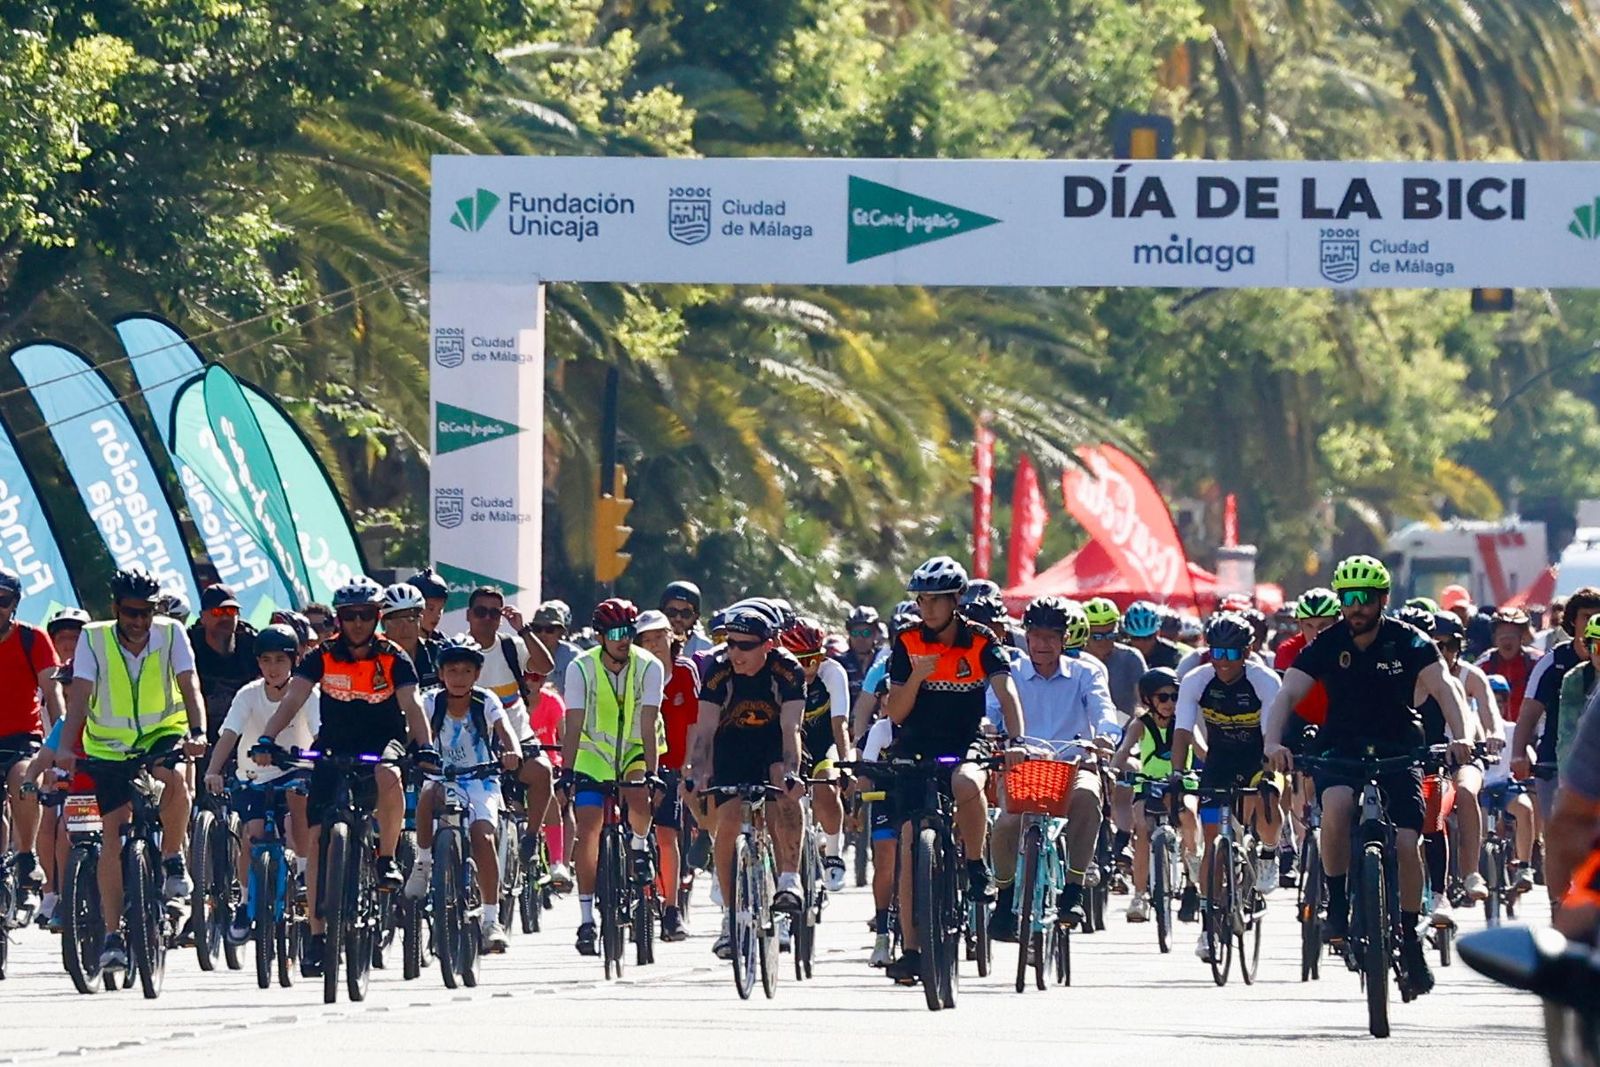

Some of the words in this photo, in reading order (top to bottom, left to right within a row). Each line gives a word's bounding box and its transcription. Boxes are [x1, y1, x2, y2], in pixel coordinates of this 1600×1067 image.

[1064, 163, 1176, 218] DÍA
[1197, 176, 1279, 219] DE
[1302, 177, 1382, 220] LA
[1403, 177, 1526, 221] BICI
[509, 192, 635, 214] Fundación
[722, 199, 786, 216] Ciudad
[852, 207, 869, 226] El
[869, 208, 905, 227] Corte
[905, 205, 960, 233] Inglés
[509, 215, 599, 242] Unicaja
[722, 220, 744, 236] de
[749, 221, 813, 240] Málaga
[1369, 238, 1429, 254] Ciudad
[1369, 259, 1390, 273] de
[1395, 259, 1455, 276] Málaga
[471, 336, 515, 348] Ciudad
[471, 351, 487, 361] de
[489, 350, 533, 364] Málaga
[470, 496, 513, 508] Ciudad
[470, 511, 486, 521] de
[489, 510, 532, 525] Málaga
